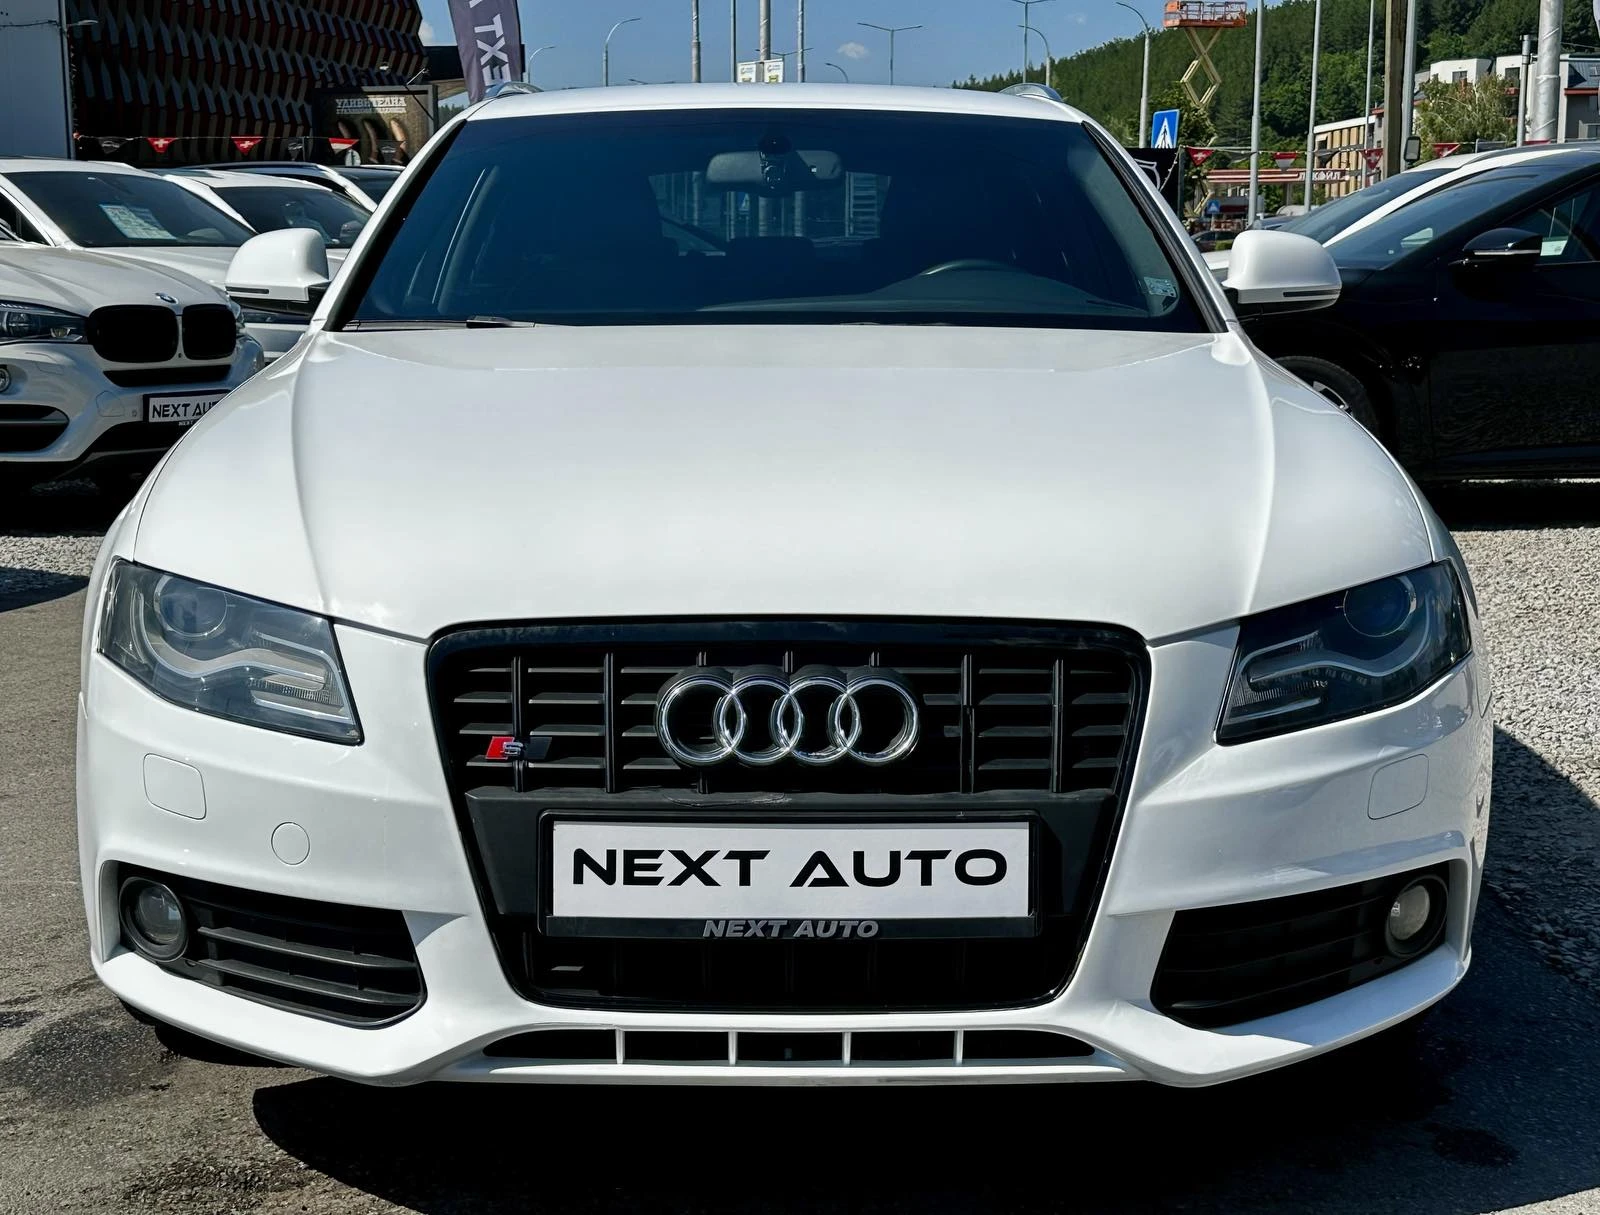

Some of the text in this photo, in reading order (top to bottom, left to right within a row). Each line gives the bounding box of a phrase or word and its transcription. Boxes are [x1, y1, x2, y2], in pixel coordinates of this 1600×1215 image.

[1299, 171, 1341, 181] ЛКОЙЛ
[152, 403, 191, 418] NEXT
[573, 847, 1008, 888] NEXT AUTO
[702, 919, 879, 938] NEXT AUTO
